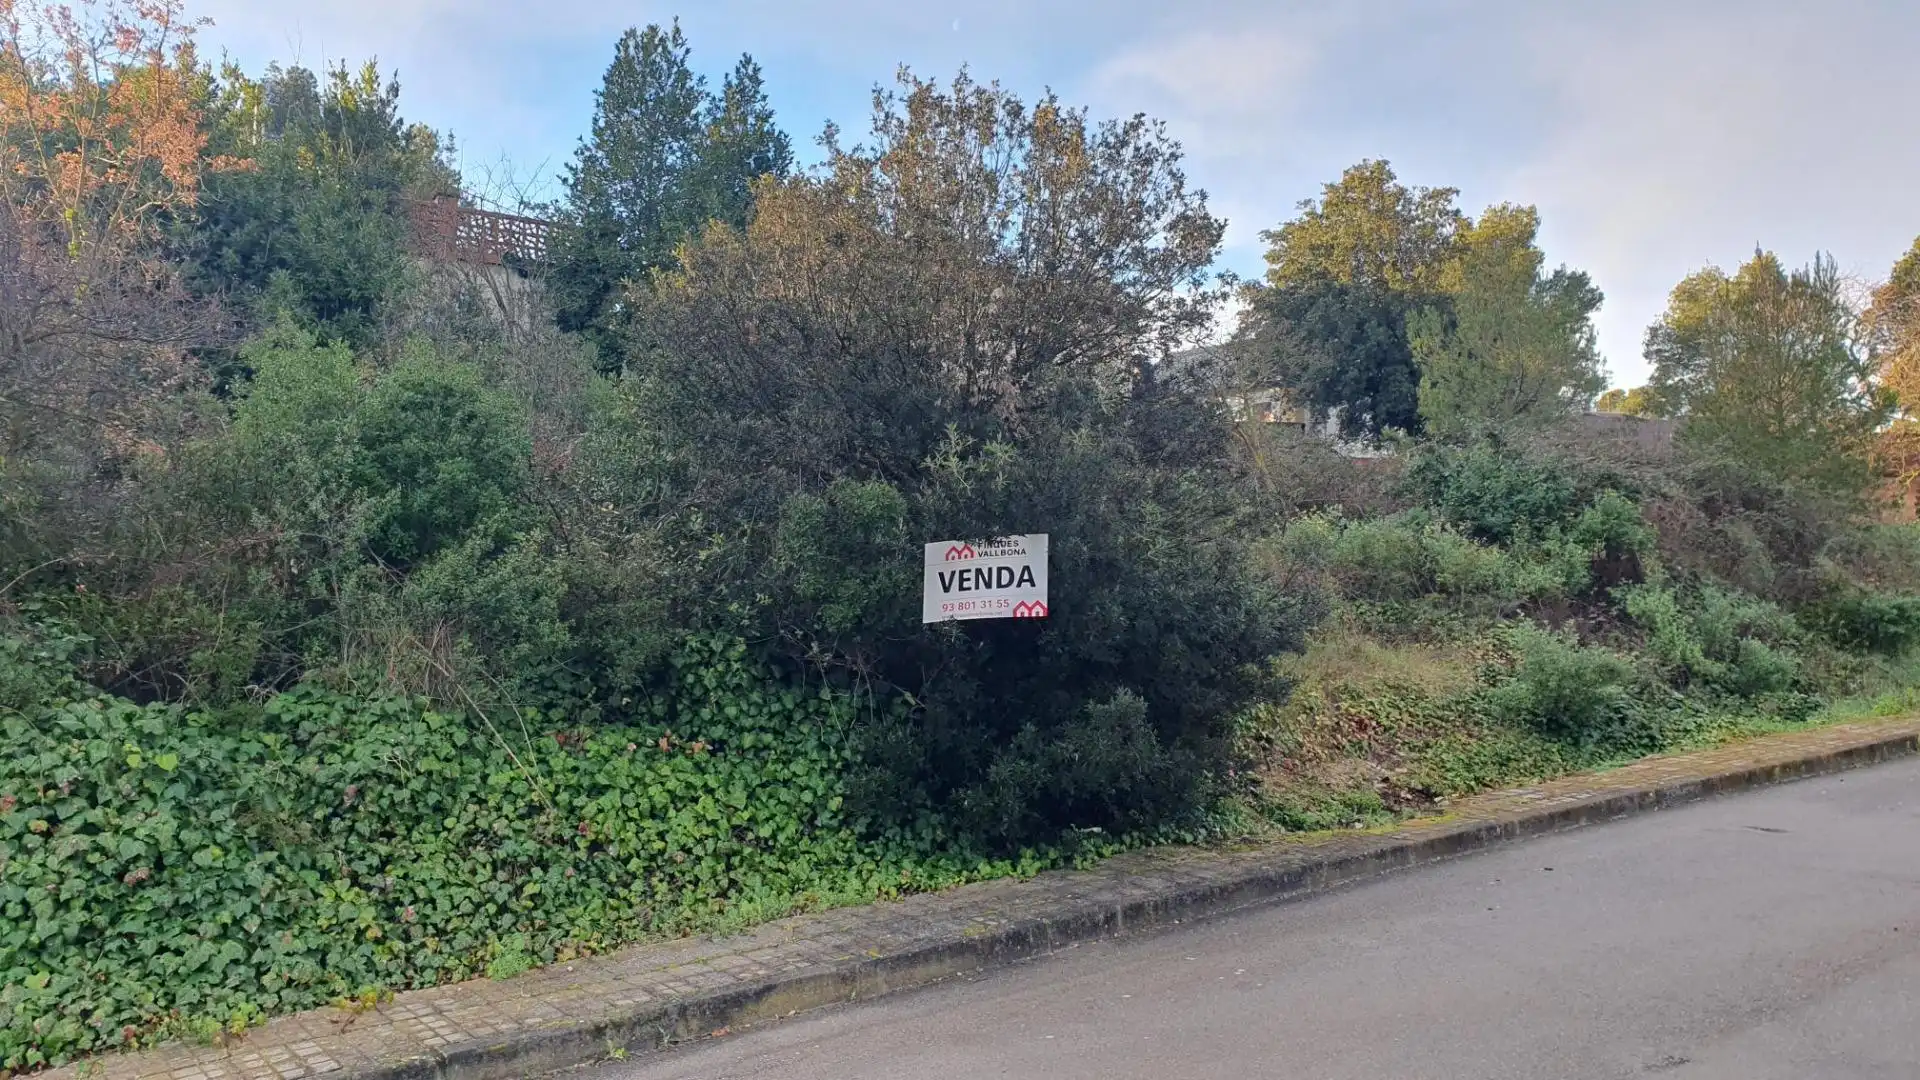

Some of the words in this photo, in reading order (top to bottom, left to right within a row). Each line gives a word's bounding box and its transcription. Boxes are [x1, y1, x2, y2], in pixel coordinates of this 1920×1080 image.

[977, 548, 1027, 558] VALLBONA
[938, 565, 1036, 593] VENDA
[942, 603, 955, 612] 93
[958, 601, 976, 611] 801
[980, 600, 992, 609] 31
[996, 599, 1010, 608] 55
